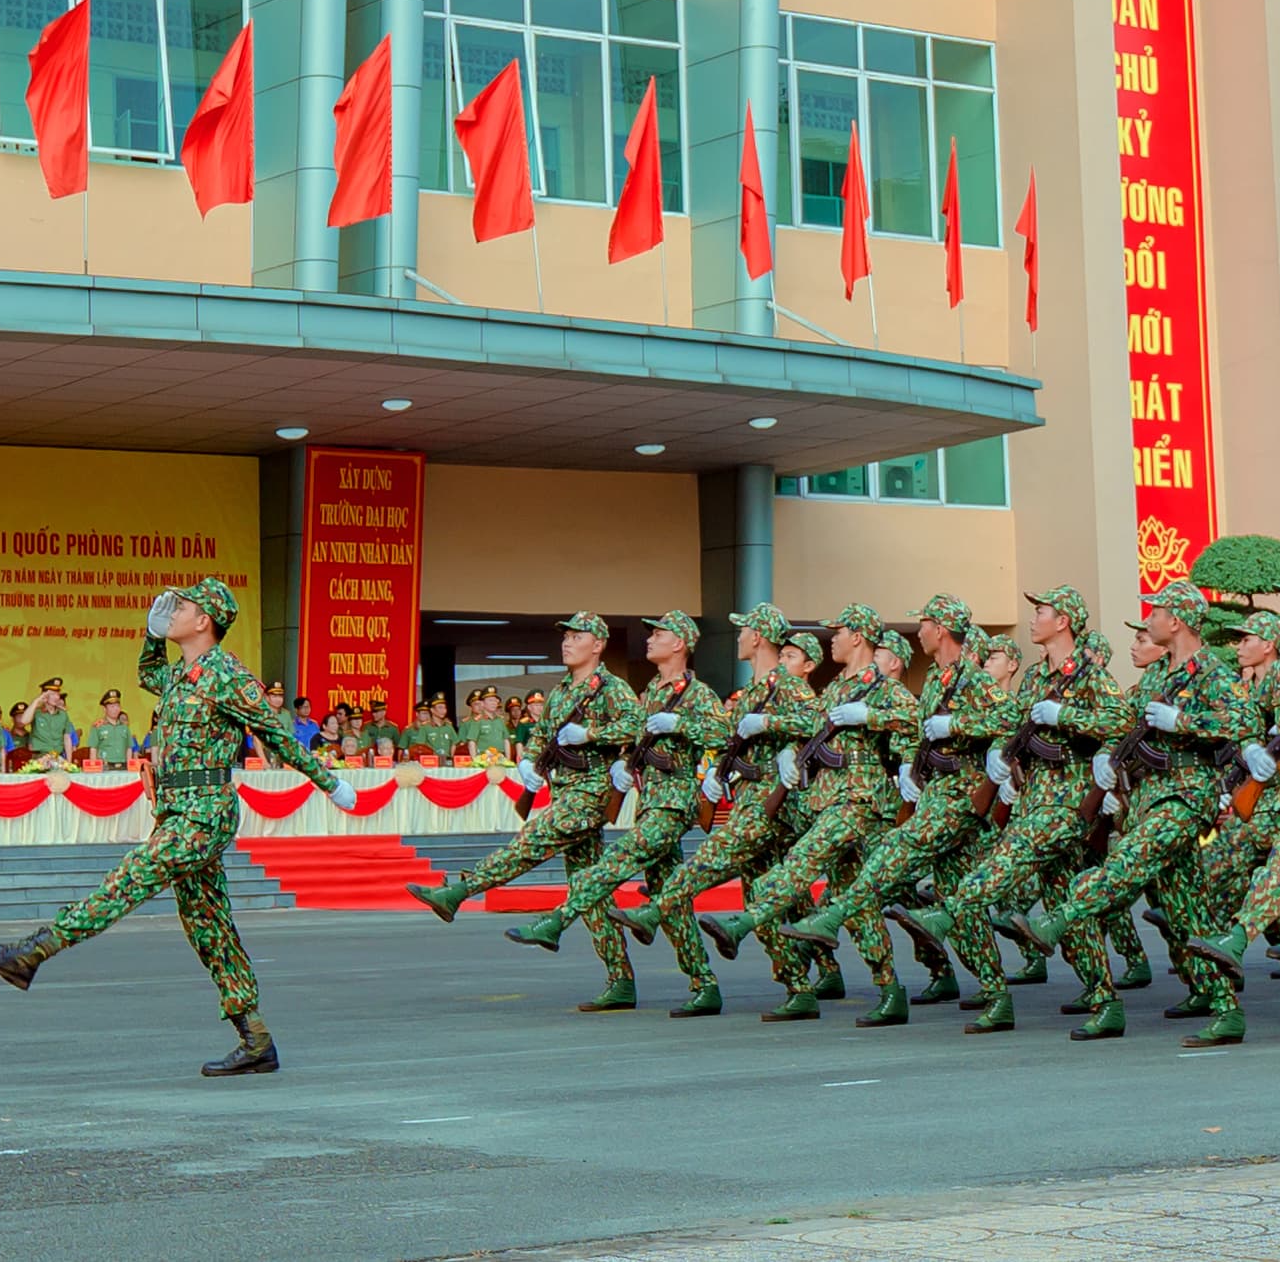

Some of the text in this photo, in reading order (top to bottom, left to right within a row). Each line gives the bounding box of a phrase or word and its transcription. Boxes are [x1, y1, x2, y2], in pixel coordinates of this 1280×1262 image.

[1130, 373, 1183, 422] HÁT
[339, 462, 392, 495] XÂY DỰNG
[320, 498, 408, 533] TRƯỜNG ĐẠI HỌC
[13, 525, 59, 558] QUỐC
[66, 529, 123, 556] PHÒNG
[130, 531, 175, 558] TOÀN
[182, 533, 216, 559] DÂN
[312, 538, 413, 565] AN NINH NHÂN DÂN
[14, 567, 35, 584] NĂM
[38, 567, 62, 584] NGÀY
[66, 567, 94, 585] THÀNH
[97, 568, 113, 588] LẬP
[116, 570, 140, 586] QUÂN
[143, 570, 158, 588] ĐỘI
[160, 570, 184, 586] NHÂN
[228, 574, 248, 587] NAM
[329, 572, 394, 606] CÁCH MẠNG,
[0, 591, 35, 608] TRƯỜNG
[38, 593, 54, 611] ĐẠI
[56, 594, 74, 611] HỌC
[77, 595, 89, 608] AN
[91, 595, 112, 608] NINH
[114, 592, 138, 609] NHÂN
[141, 593, 156, 609] DÂ
[330, 610, 390, 642] CHÍNH QUY,
[329, 647, 389, 680] TINH NHUỆ,
